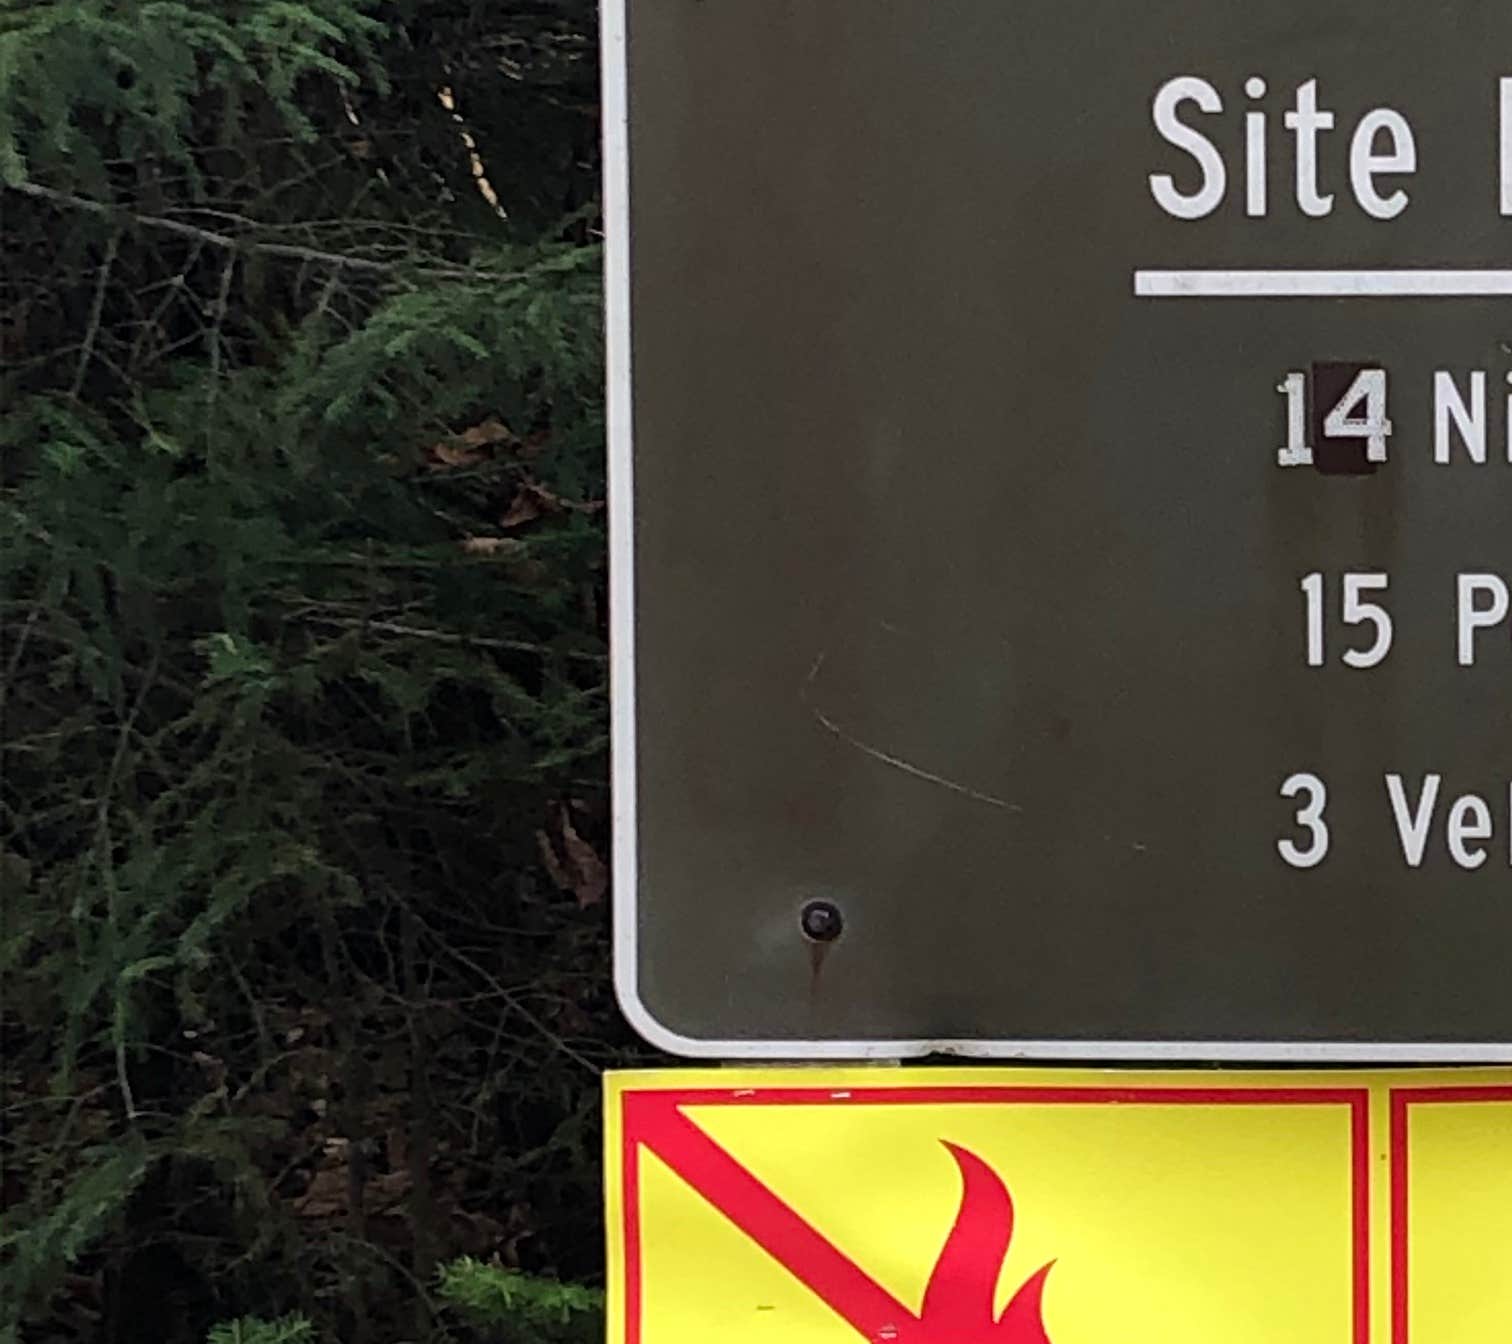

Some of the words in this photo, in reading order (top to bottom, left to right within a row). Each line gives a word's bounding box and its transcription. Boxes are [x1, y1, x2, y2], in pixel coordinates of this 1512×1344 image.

[1149, 76, 1417, 221] Site
[1277, 368, 1392, 467] 14
[1301, 573, 1393, 668] 15
[1277, 773, 1329, 868] 3
